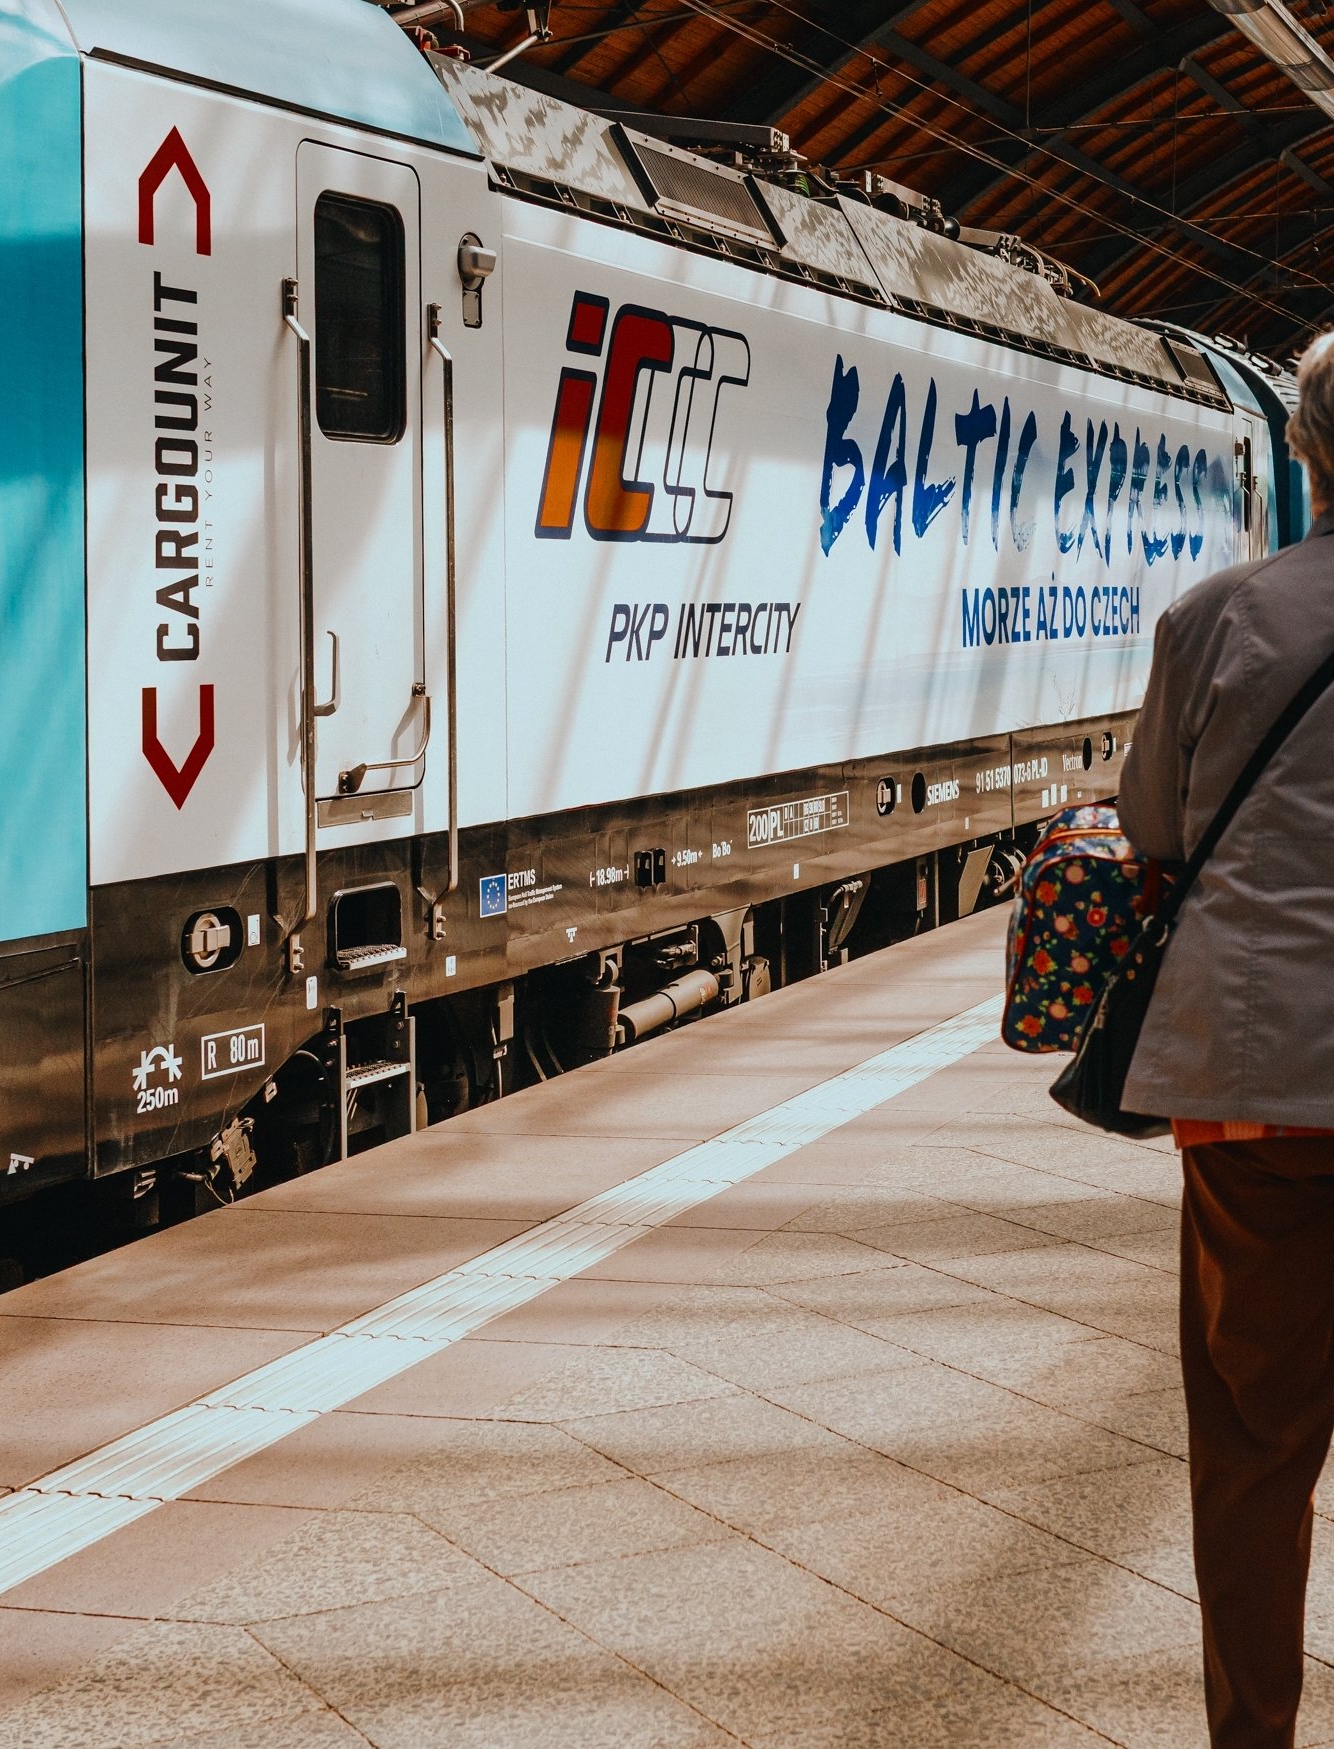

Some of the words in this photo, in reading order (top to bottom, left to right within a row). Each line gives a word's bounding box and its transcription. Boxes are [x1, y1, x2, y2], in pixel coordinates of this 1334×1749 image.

[203, 357, 213, 412] WAY
[153, 270, 200, 662] CARGOUNIT
[204, 430, 214, 502] YOUR
[819, 353, 1038, 558] BALTIC
[1053, 410, 1208, 569] EXPRESS
[204, 520, 214, 588] RENT
[961, 586, 1031, 648] MORZE
[1036, 572, 1058, 641] AŻ
[1063, 585, 1087, 639] DO
[1091, 585, 1140, 637] CZECH
[605, 603, 670, 663] PKP
[673, 602, 801, 660] INTERCITY
[975, 772, 985, 794] 91
[985, 769, 994, 792] 51
[995, 765, 1011, 789] 5370
[1013, 761, 1031, 784] 073-6
[1031, 757, 1048, 780] PL-ID
[1062, 754, 1083, 772] Vectron
[927, 779, 960, 806] SIEMENS
[749, 813, 768, 842] 200
[770, 810, 784, 839] PL
[596, 866, 624, 887] 18.98m
[676, 848, 698, 868] 9.50m
[508, 868, 536, 891] ERTMS
[207, 1040, 217, 1070] R
[229, 1033, 246, 1065] 80
[247, 1035, 260, 1060] m
[136, 1085, 179, 1114] 250m
